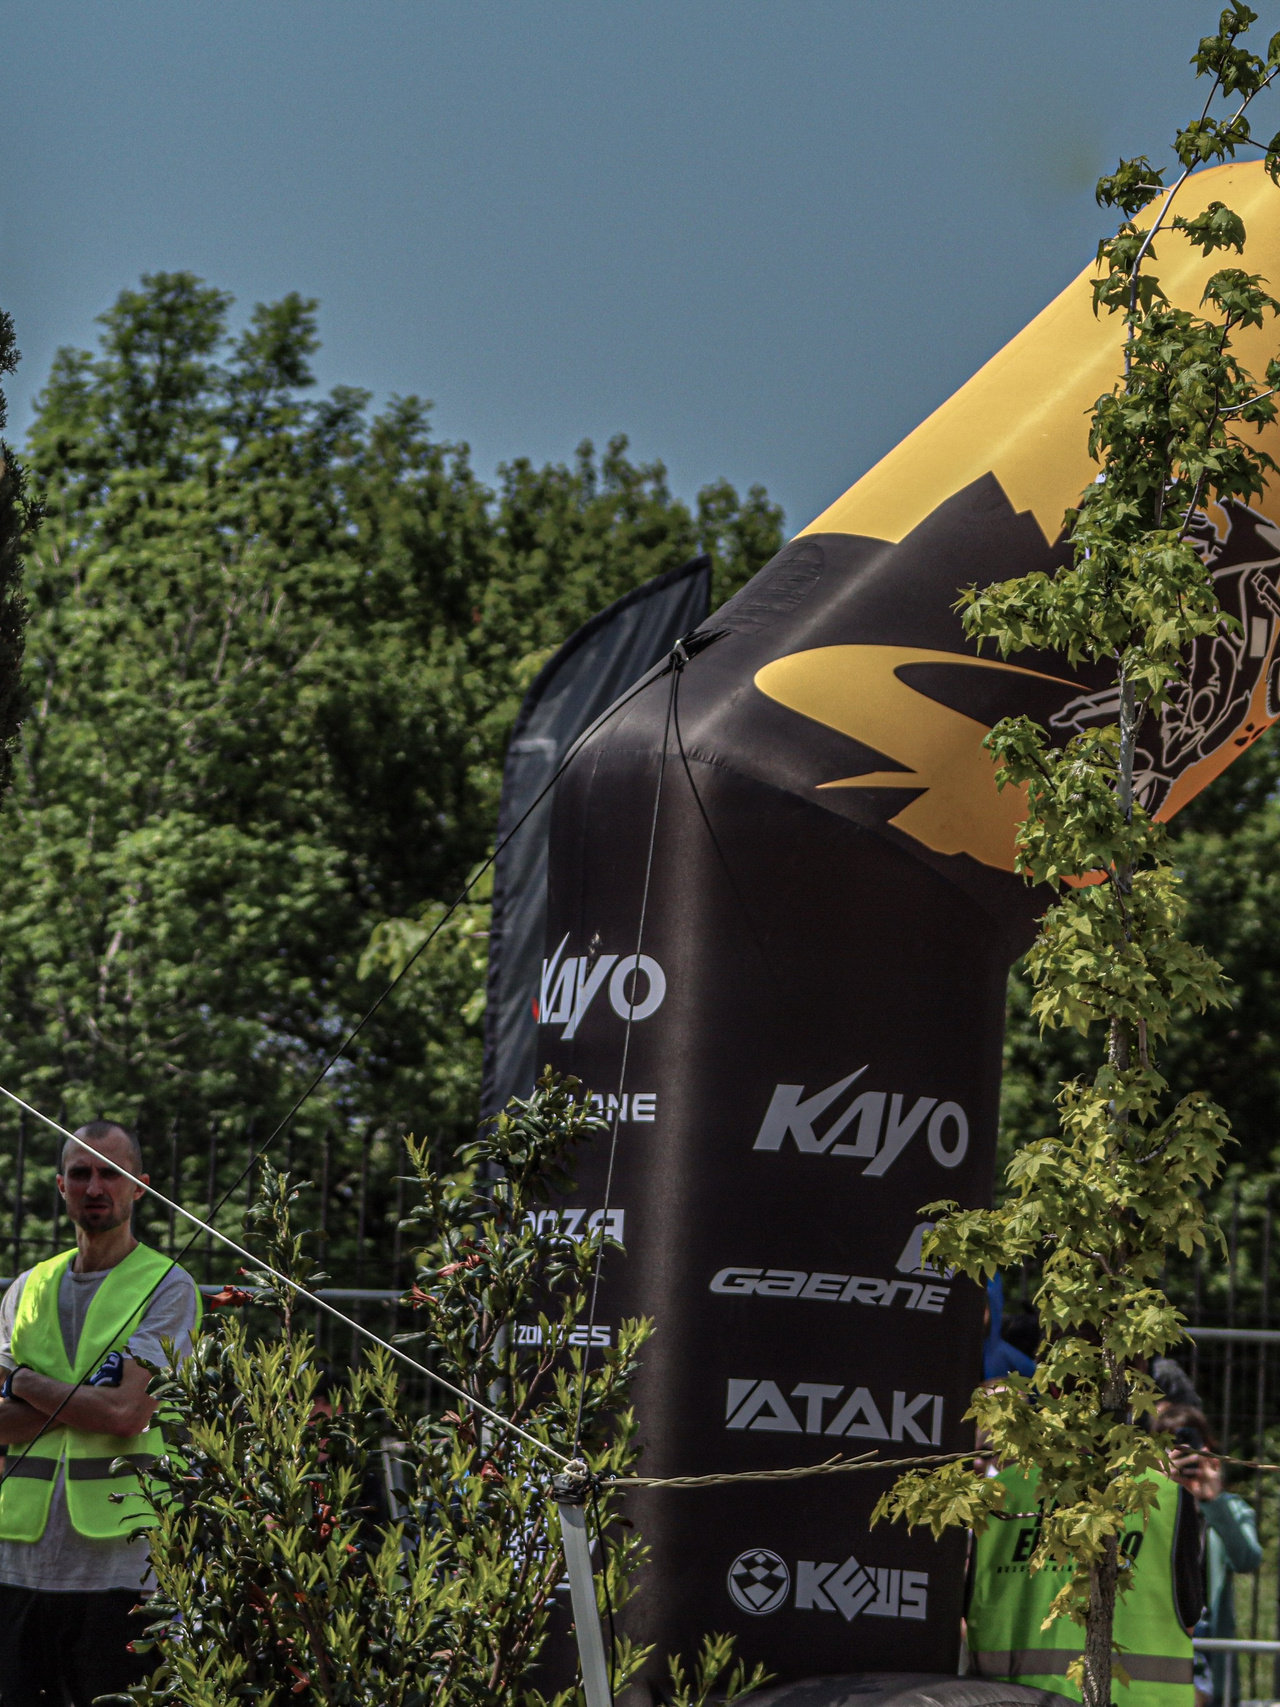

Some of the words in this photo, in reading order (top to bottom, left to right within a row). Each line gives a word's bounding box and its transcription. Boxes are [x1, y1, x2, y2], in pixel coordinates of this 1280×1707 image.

[753, 1064, 969, 1177] KAYO
[709, 1266, 951, 1313] GAERNE
[725, 1378, 943, 1446] ATAKI
